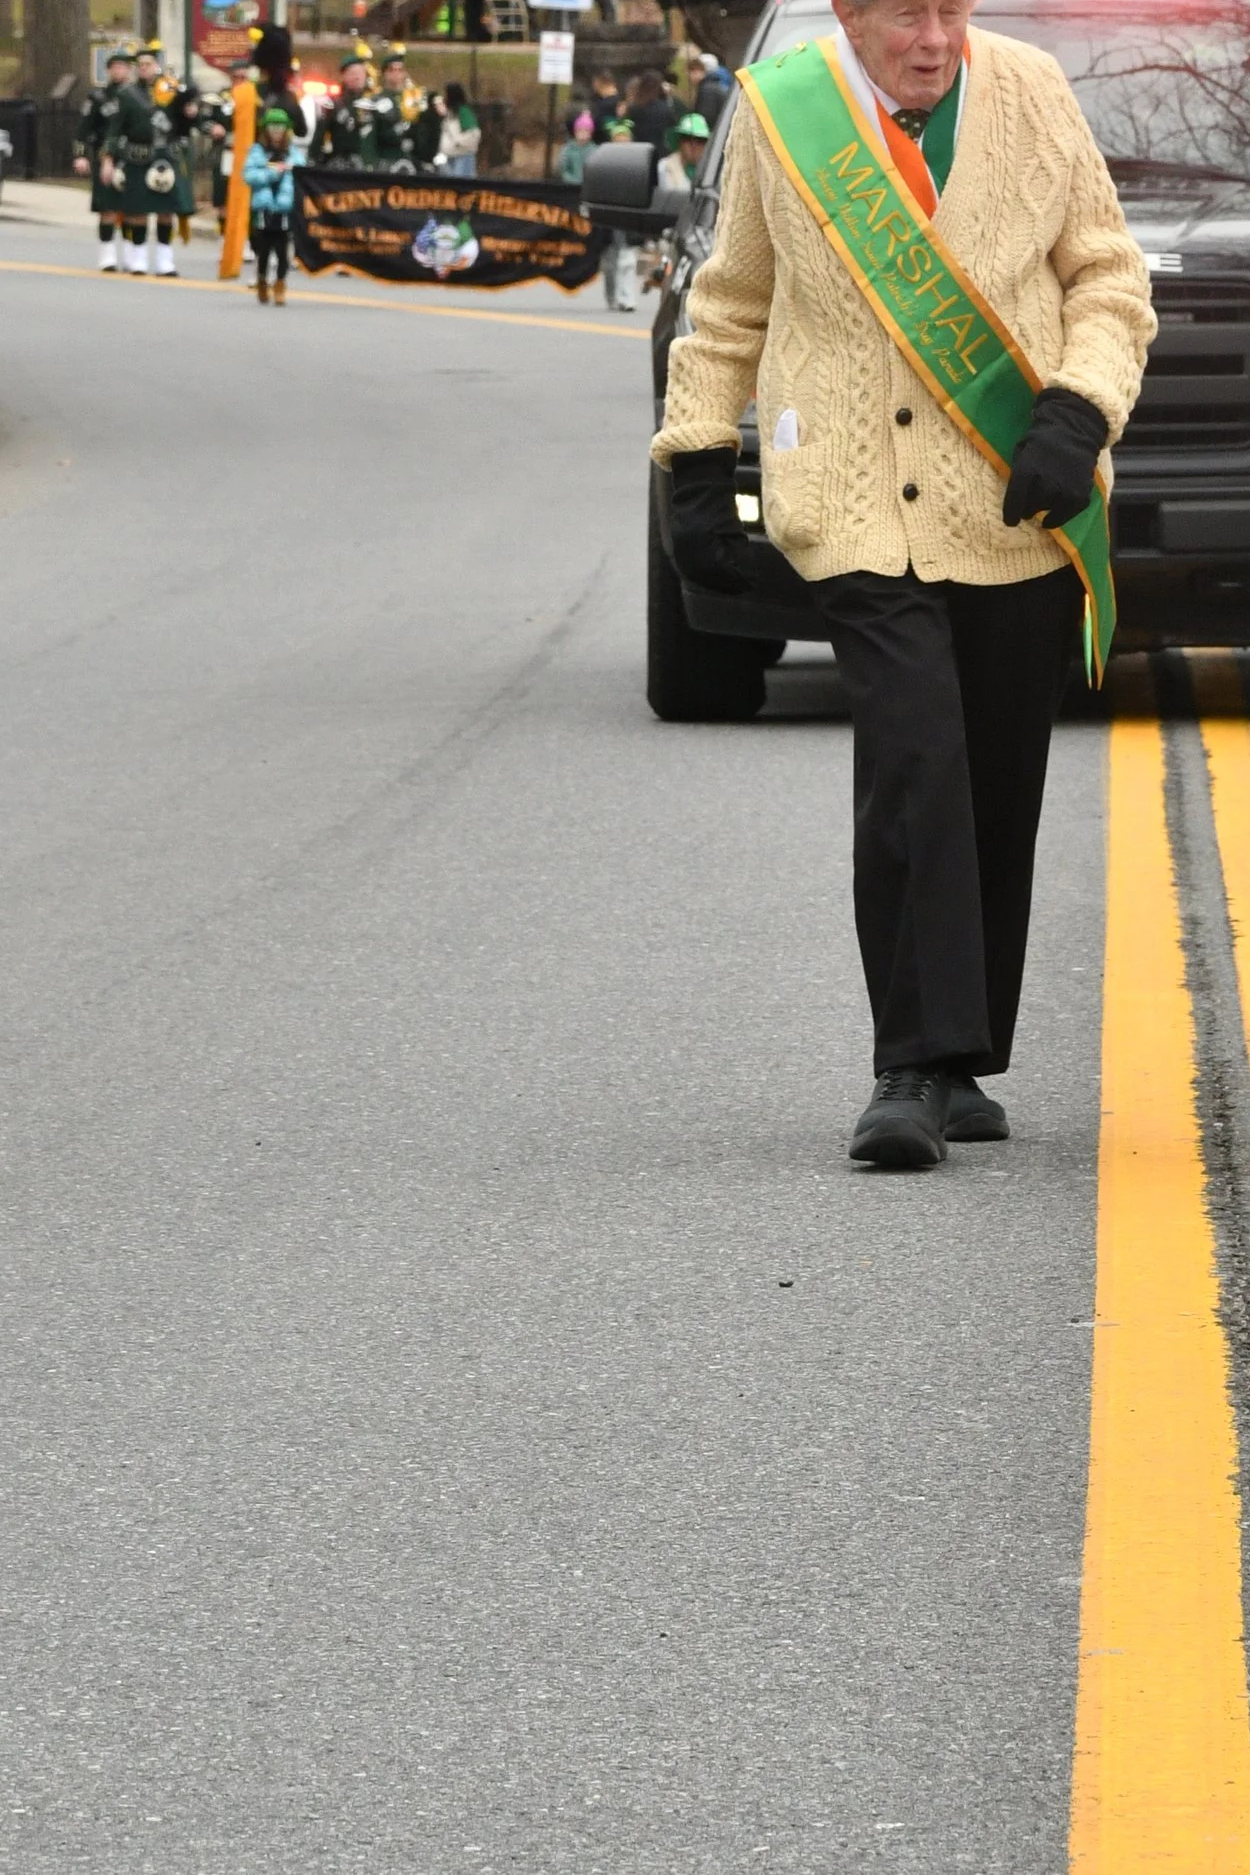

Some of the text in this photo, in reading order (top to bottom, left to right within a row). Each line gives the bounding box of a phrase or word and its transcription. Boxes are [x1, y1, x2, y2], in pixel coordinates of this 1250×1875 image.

[387, 185, 457, 210] ORDER
[829, 140, 988, 375] MARSHAL
[915, 321, 934, 346] Day
[930, 347, 963, 385] Parade
